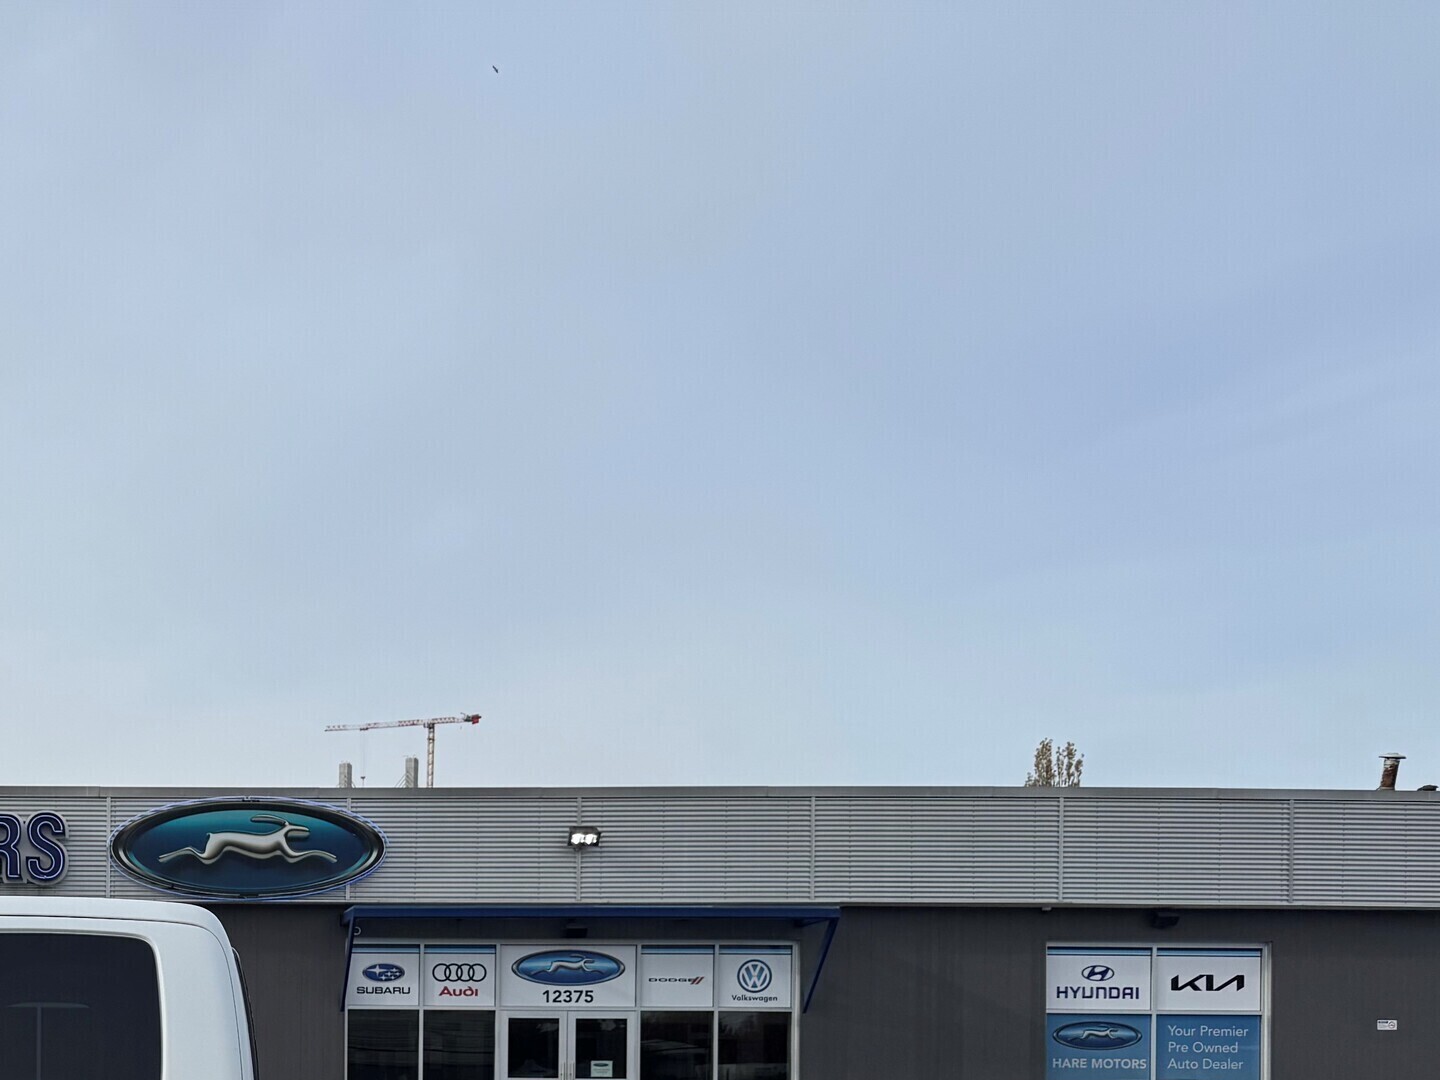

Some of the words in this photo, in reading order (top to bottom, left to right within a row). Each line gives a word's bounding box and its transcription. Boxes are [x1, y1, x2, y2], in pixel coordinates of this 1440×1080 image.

[1170, 974, 1245, 992] KIA
[356, 986, 411, 995] SUBARU
[439, 985, 479, 997] Audi
[1056, 986, 1140, 1000] HYUNDAI
[542, 990, 595, 1004] 12375
[731, 994, 778, 1003] Volkswagen
[1167, 1025, 1197, 1037] Your
[1200, 1025, 1249, 1037] Premier
[1168, 1042, 1189, 1054] Pre
[1192, 1041, 1239, 1054] Owned
[1052, 1058, 1088, 1070] HARE
[1091, 1058, 1147, 1070] MOTORS
[1167, 1058, 1199, 1070] Auto
[1202, 1058, 1244, 1070] Dealer
